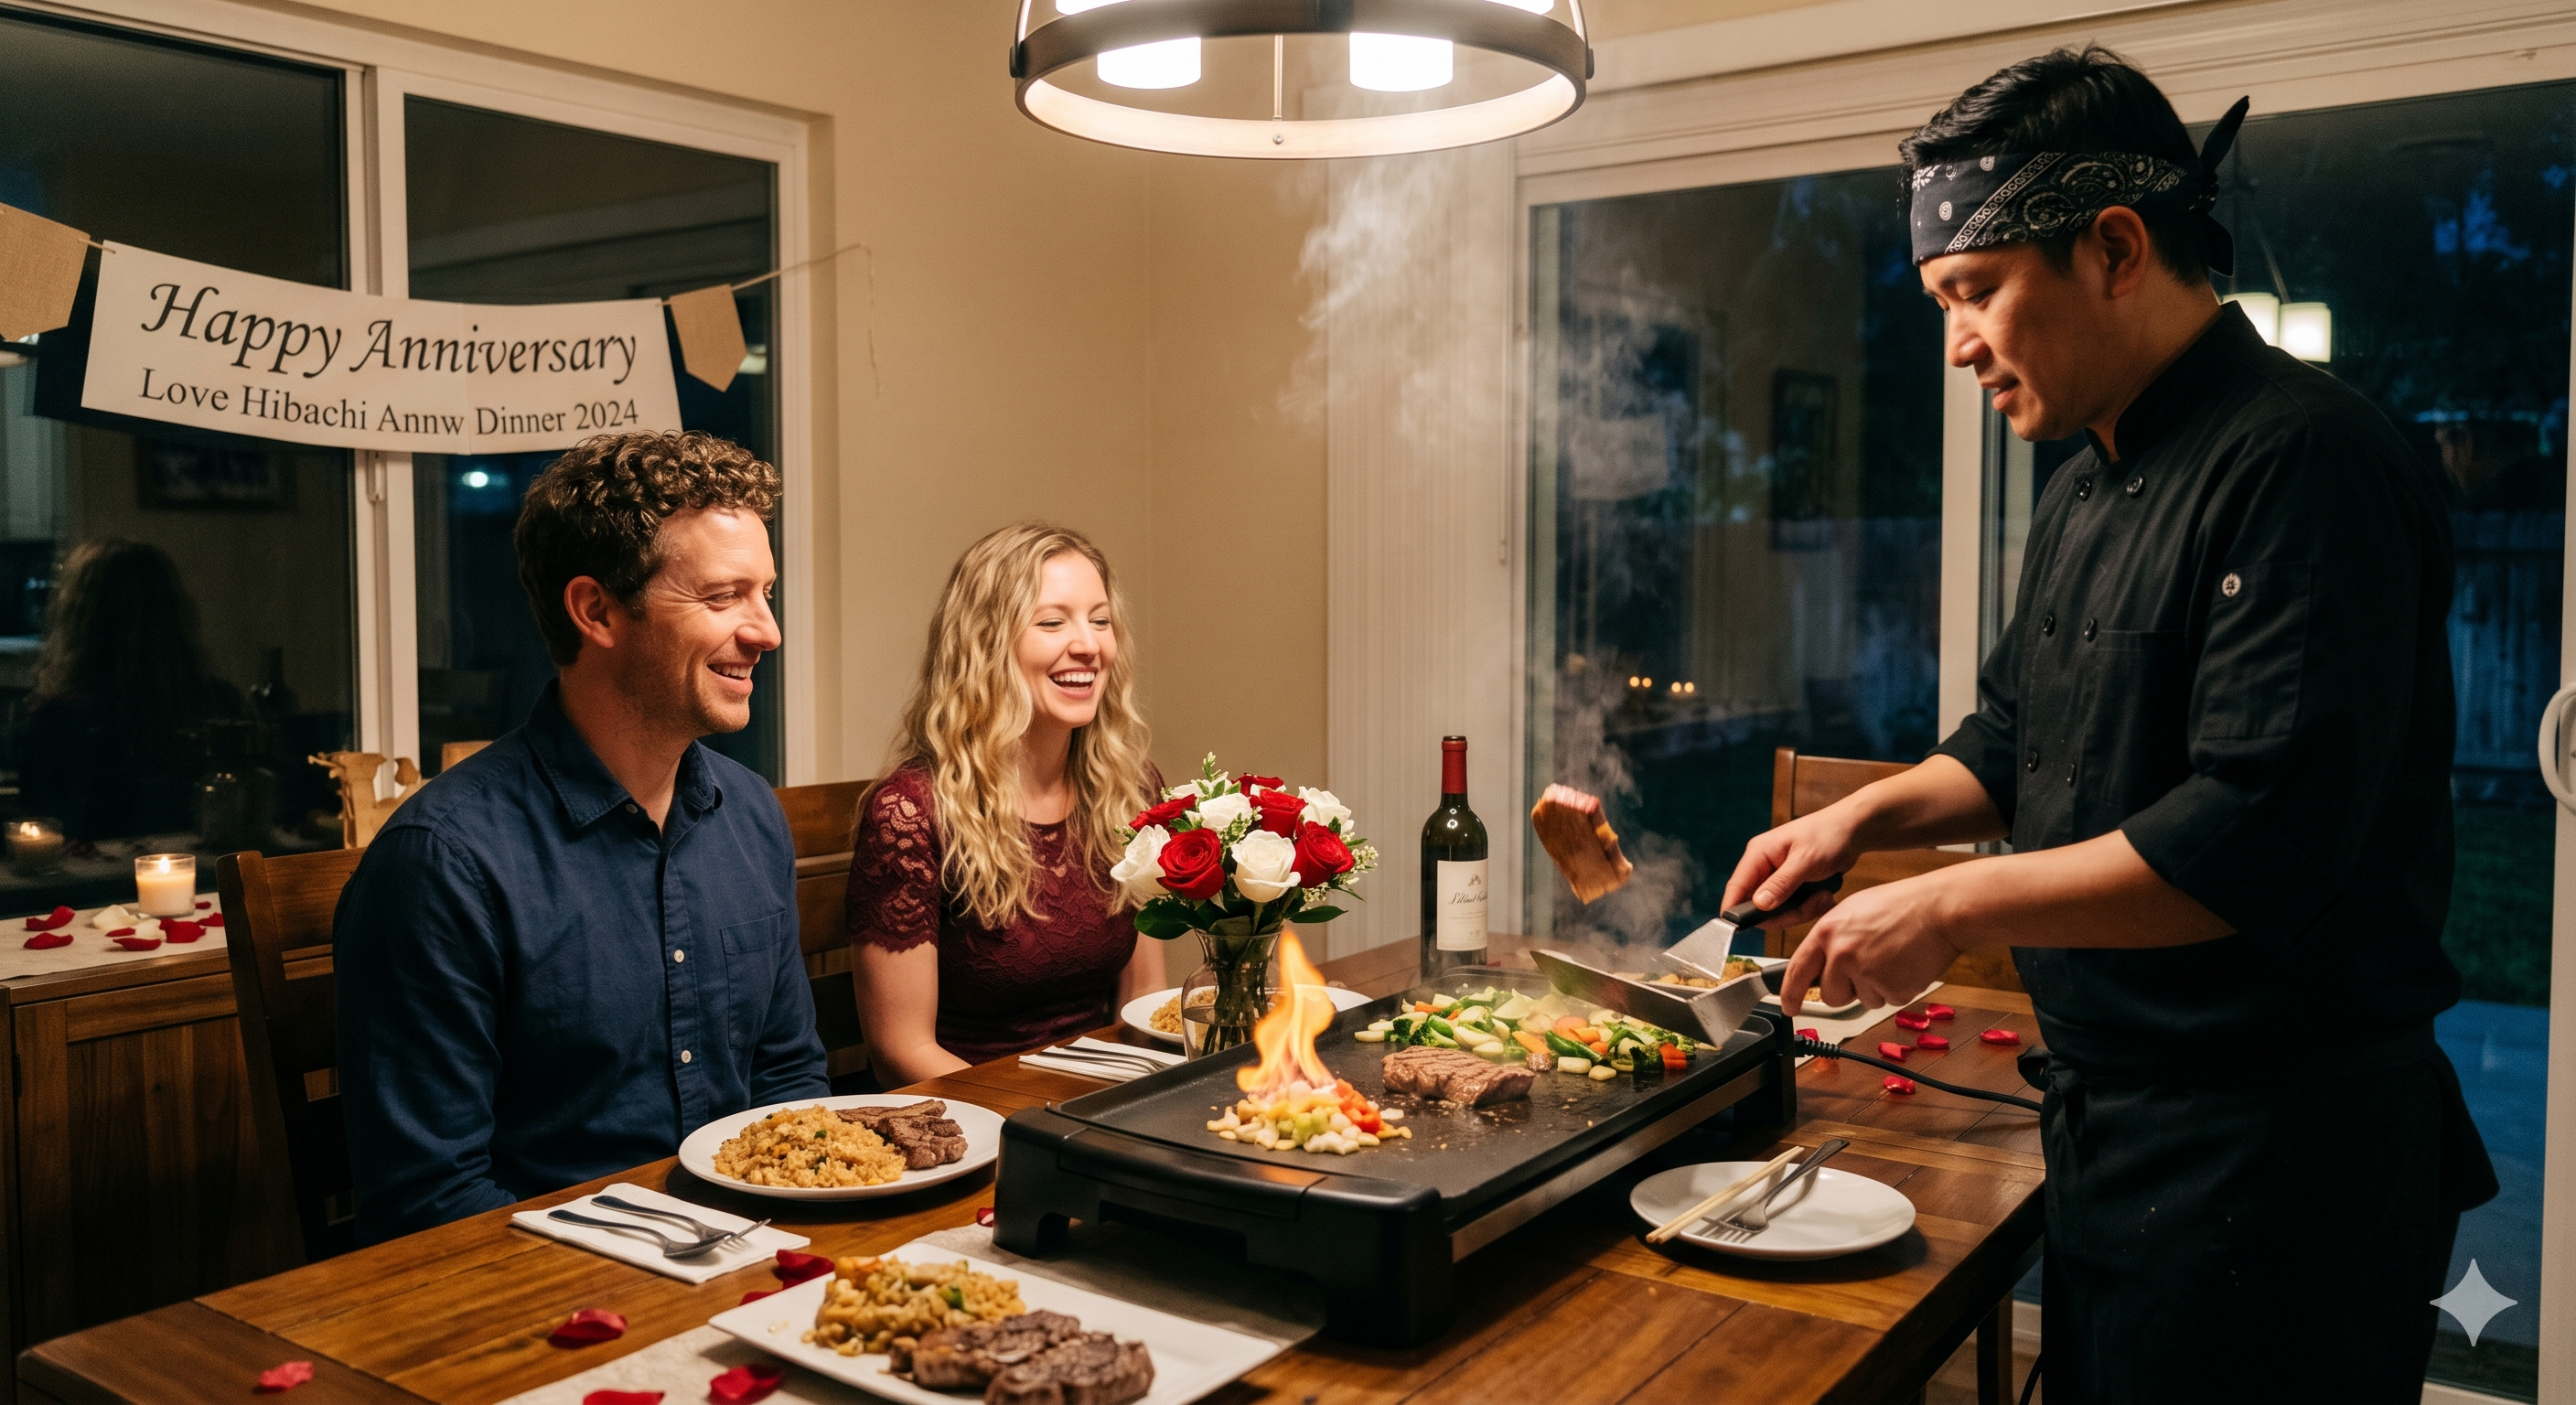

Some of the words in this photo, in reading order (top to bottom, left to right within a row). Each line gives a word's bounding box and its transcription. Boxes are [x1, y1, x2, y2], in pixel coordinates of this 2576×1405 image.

[140, 283, 342, 378] Happy
[349, 319, 637, 385] Anniversary
[138, 368, 229, 412] Love
[240, 386, 367, 431] Hibachi
[377, 403, 465, 435] Annw
[475, 406, 566, 435] Dinner
[574, 399, 639, 430] 2024
